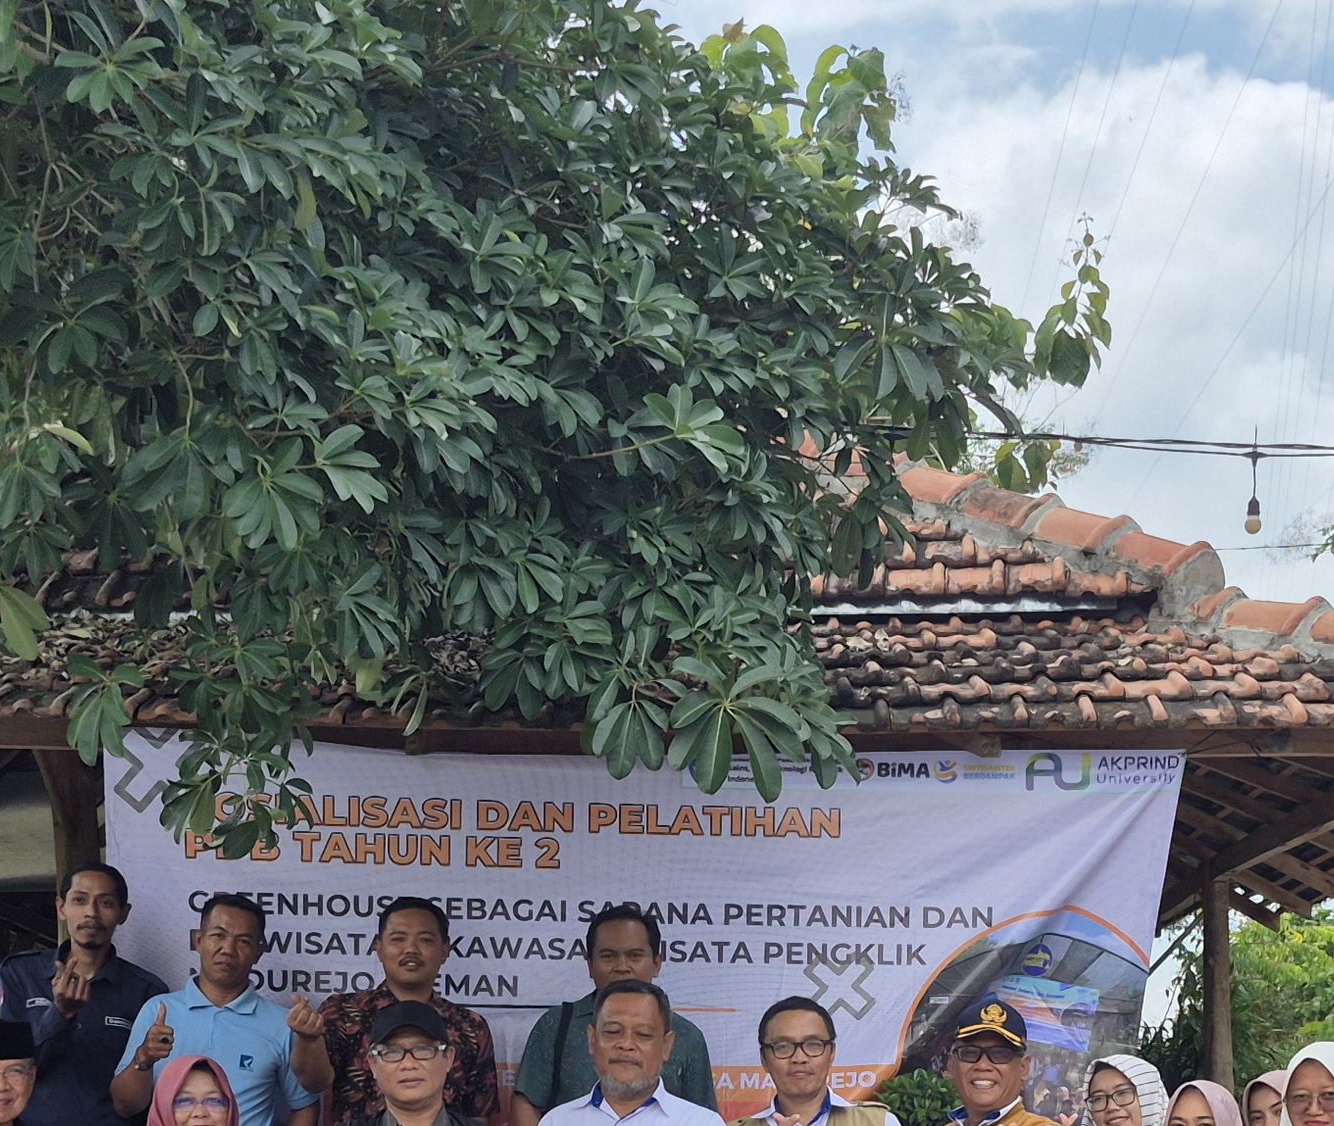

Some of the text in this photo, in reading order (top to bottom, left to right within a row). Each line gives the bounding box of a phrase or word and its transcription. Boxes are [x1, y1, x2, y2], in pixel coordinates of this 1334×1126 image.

[1096, 772, 1176, 785] University
[1097, 755, 1180, 771] AKPRIND
[190, 791, 841, 838] OSALISASI DAN PELATIHAN
[184, 827, 560, 869] PB TAHUN KE 2
[188, 890, 409, 919] GENHOUS
[723, 903, 911, 928] PERTANIAN
[922, 906, 993, 929] DAN
[190, 928, 927, 966] WISAT KAWASA ISATA PENGKLIK
[190, 968, 518, 998] DUREJO EMAN
[740, 1070, 877, 1090] MAEJO
